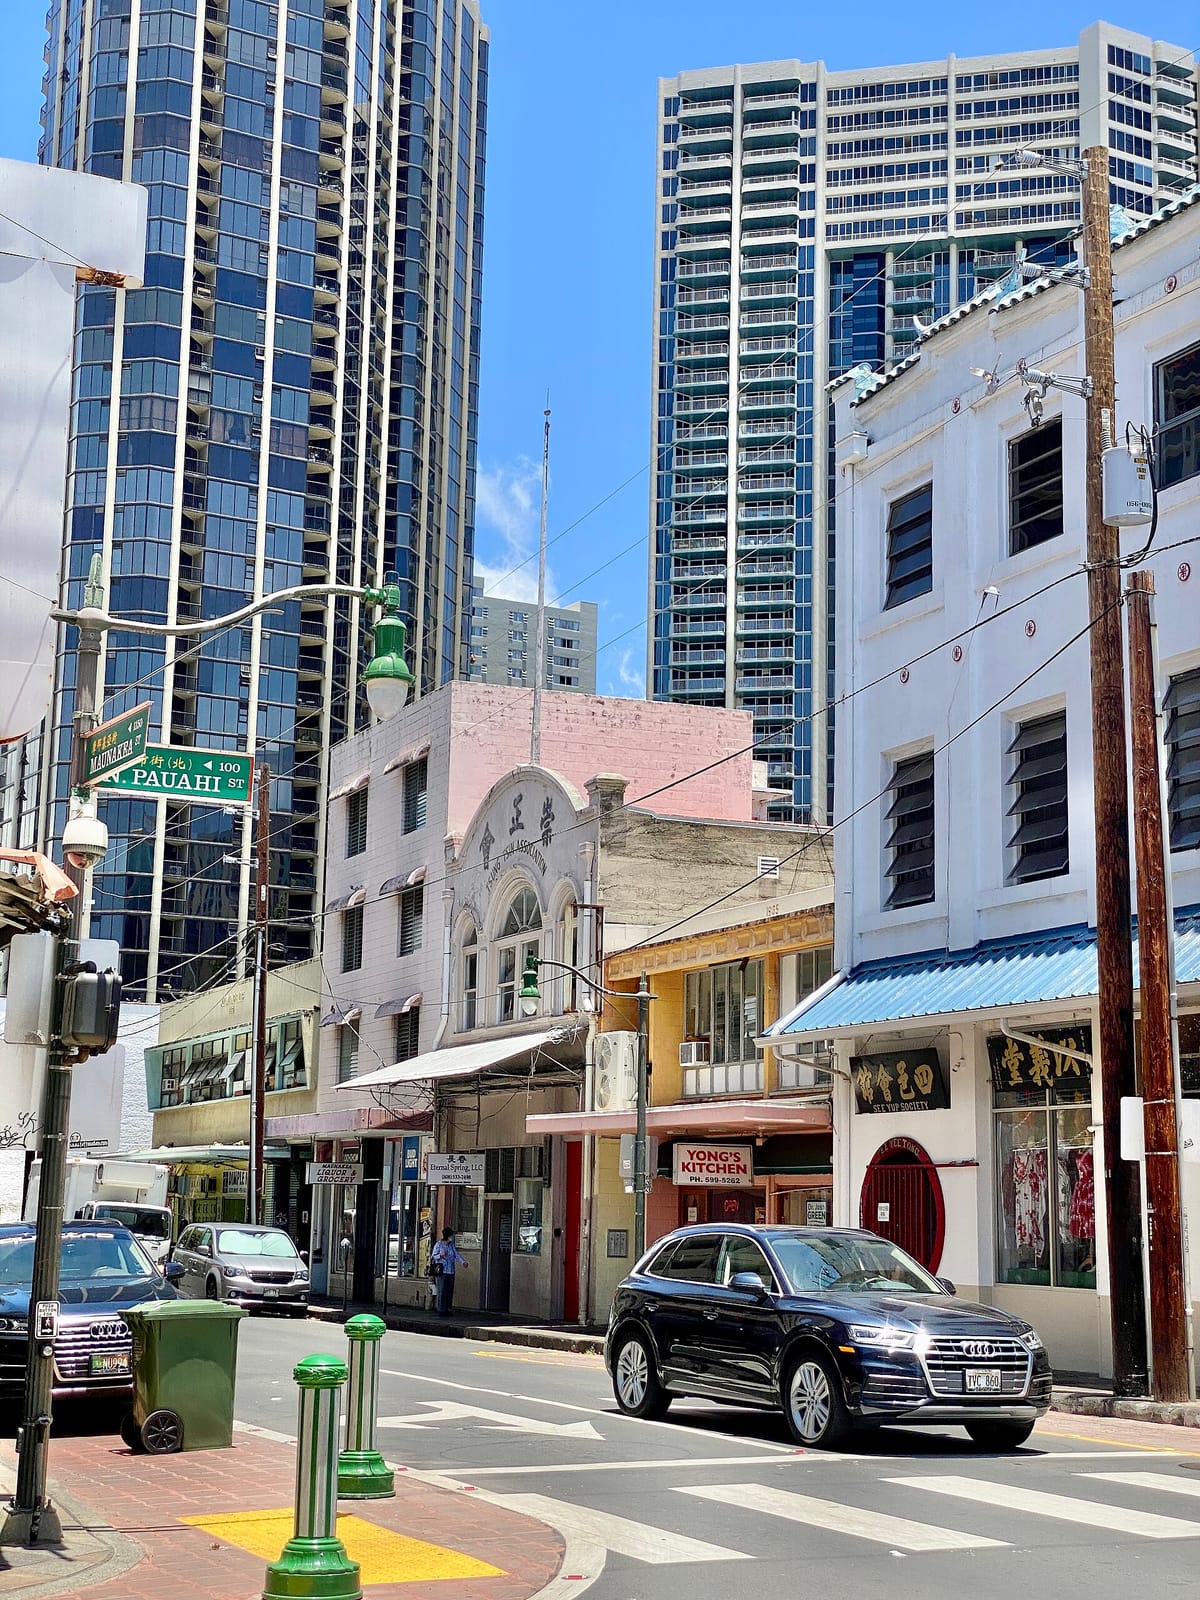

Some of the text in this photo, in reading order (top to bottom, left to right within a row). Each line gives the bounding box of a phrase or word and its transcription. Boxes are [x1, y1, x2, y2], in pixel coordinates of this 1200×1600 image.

[90, 738, 133, 774] MAUNAKEA
[135, 733, 142, 746] ST
[218, 762, 241, 773] 100
[131, 769, 221, 793] PAUAHI
[228, 778, 245, 789] ST
[515, 839, 548, 877] ASSOCIATION
[873, 1101, 929, 1113] SEE YUP SOCIETY
[902, 1138, 920, 1157] TONG
[687, 1150, 741, 1162] YONG'S
[450, 1164, 470, 1172] Spring,
[681, 1162, 747, 1174] KITCHEN
[317, 1175, 356, 1183] GROCERY
[807, 1211, 826, 1220] GREEN
[967, 1375, 999, 1387] TVC 860
